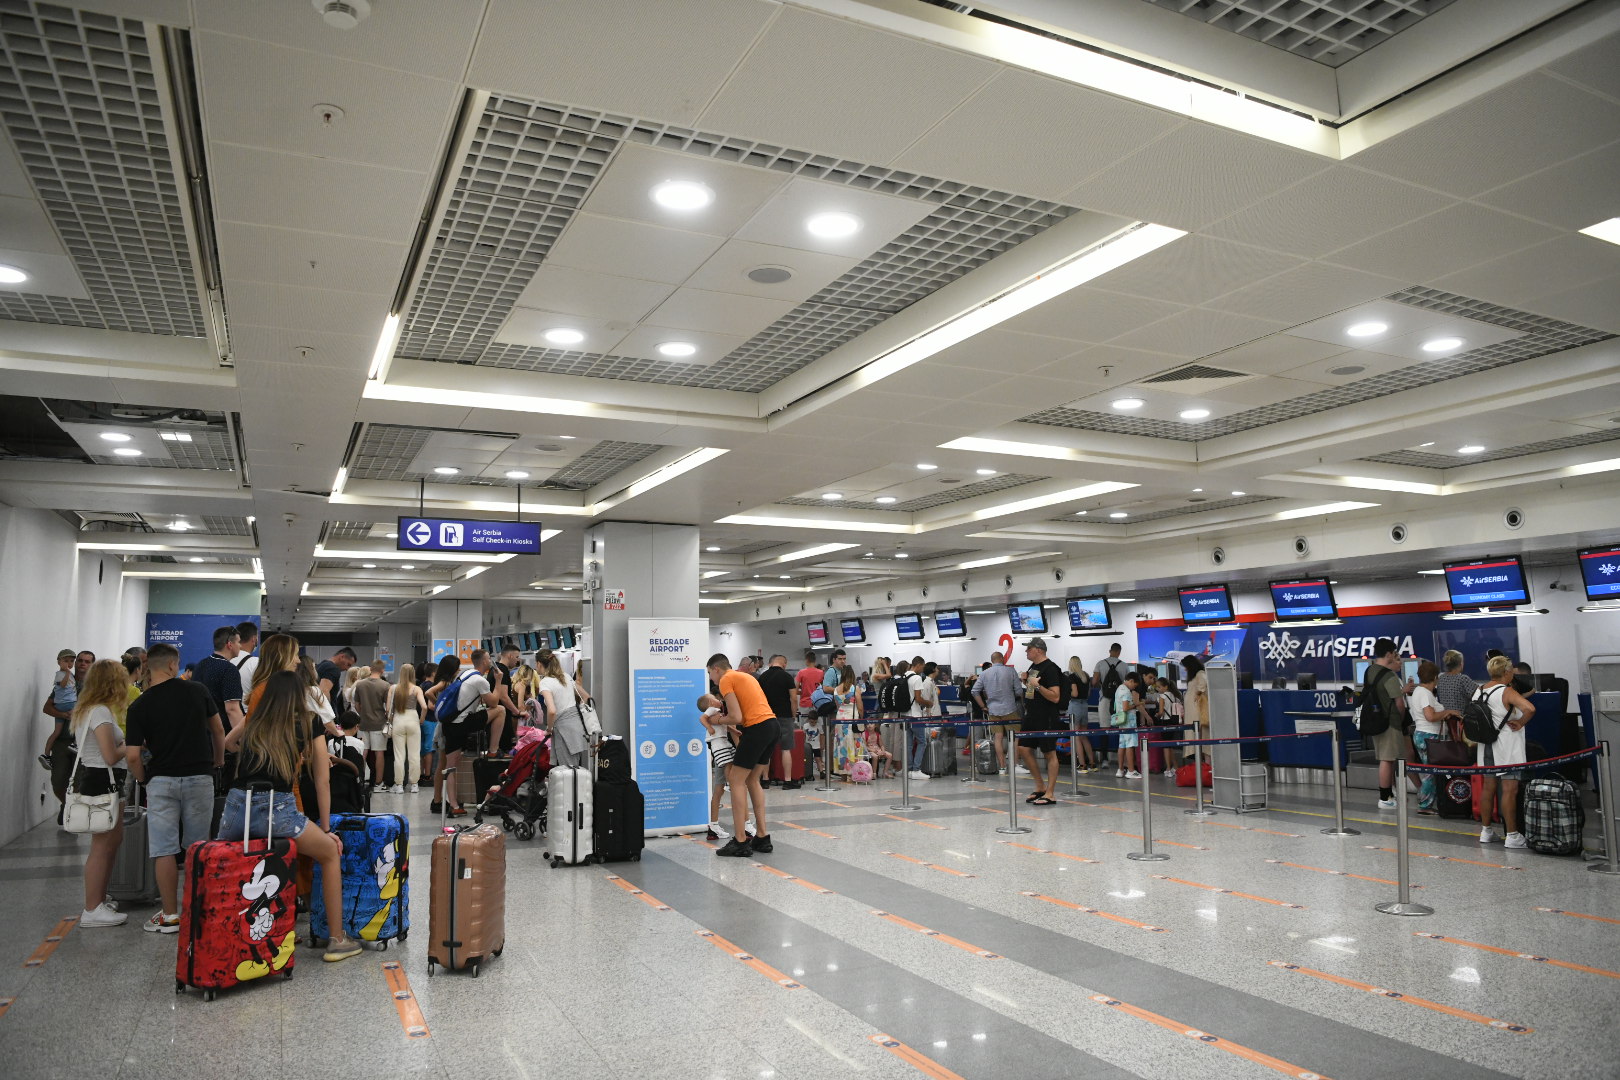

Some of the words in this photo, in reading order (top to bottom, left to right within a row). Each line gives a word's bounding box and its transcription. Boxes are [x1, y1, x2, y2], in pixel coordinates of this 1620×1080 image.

[1474, 575, 1508, 584] AirSERBIA
[998, 634, 1014, 667] 2
[1314, 692, 1336, 709] 208
